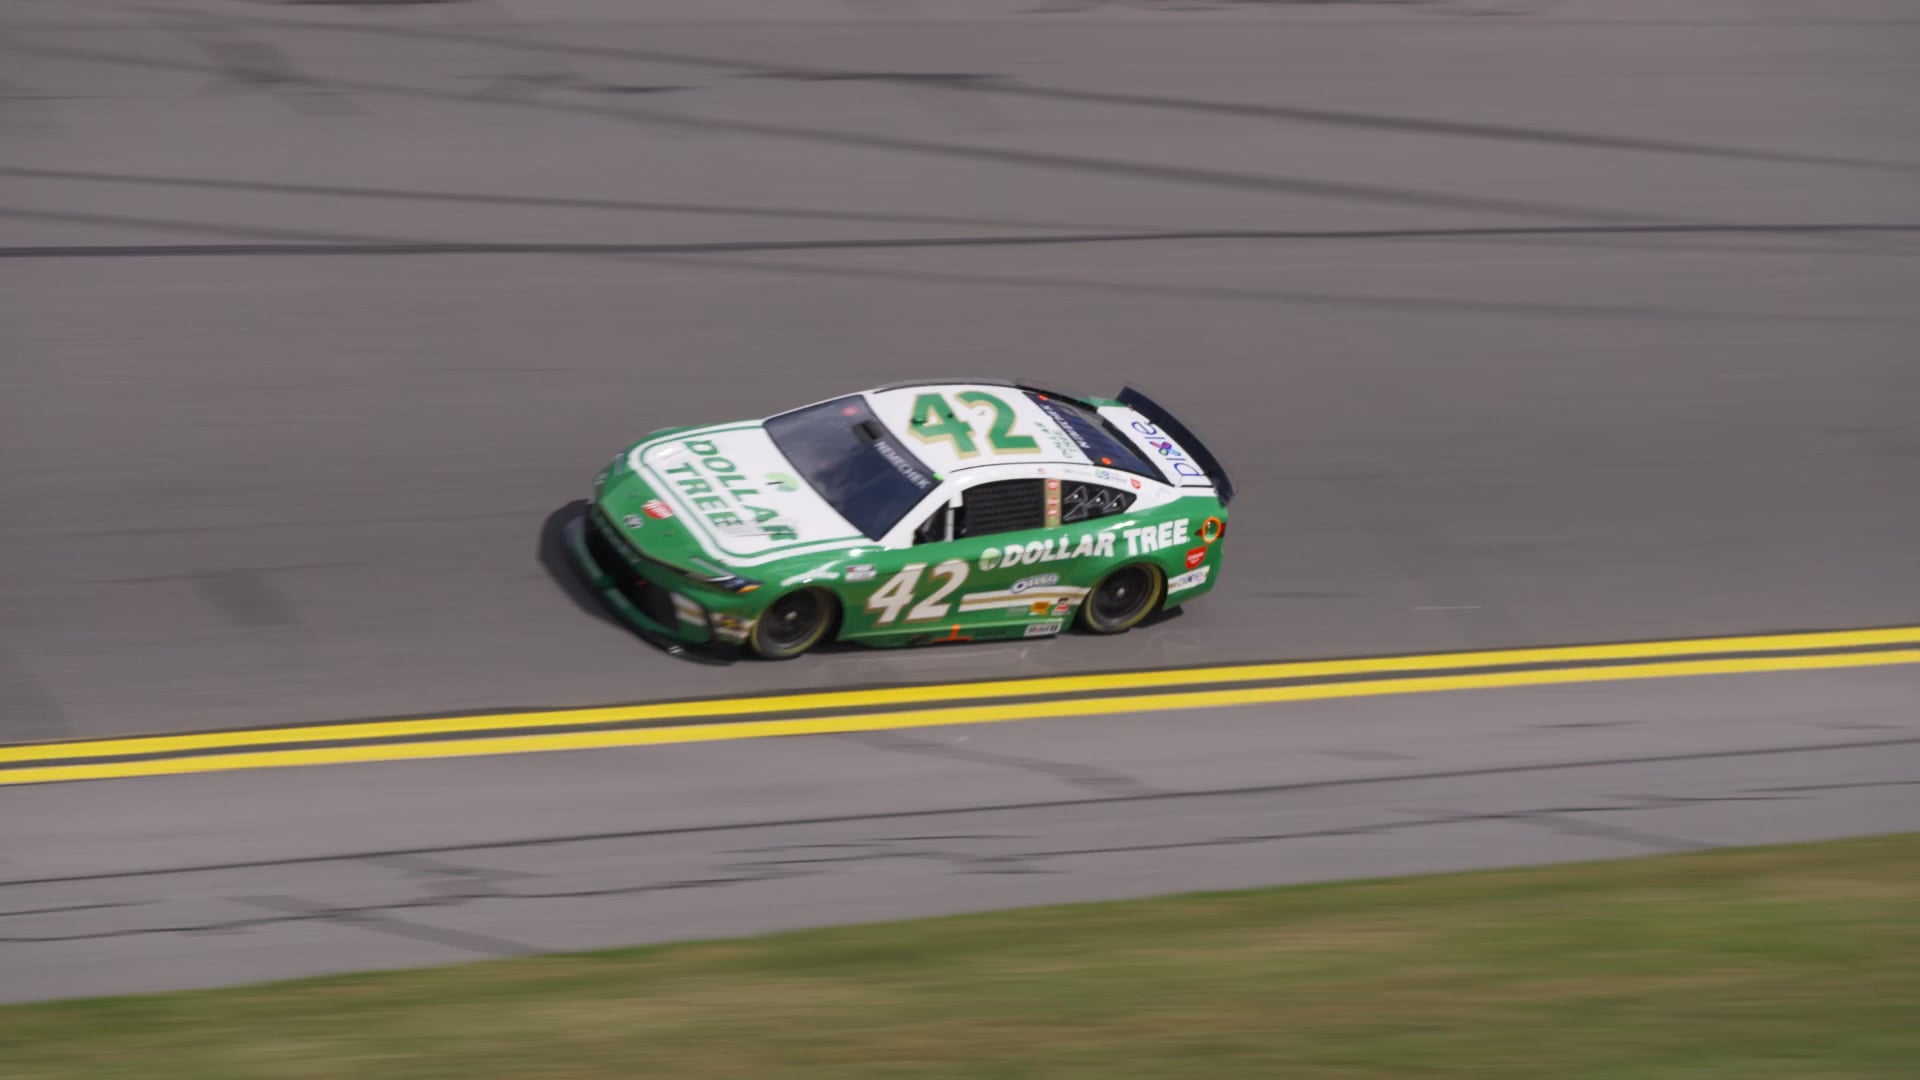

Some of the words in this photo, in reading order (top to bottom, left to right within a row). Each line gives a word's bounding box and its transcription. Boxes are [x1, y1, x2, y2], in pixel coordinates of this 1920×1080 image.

[907, 391, 1042, 460] 42
[665, 463, 744, 527] TREE
[684, 440, 798, 541] DOLLAR
[873, 441, 931, 490] NEMECHEK
[1000, 530, 1117, 569] DOLLAR
[1123, 518, 1190, 557] TREE
[864, 558, 971, 628] 42
